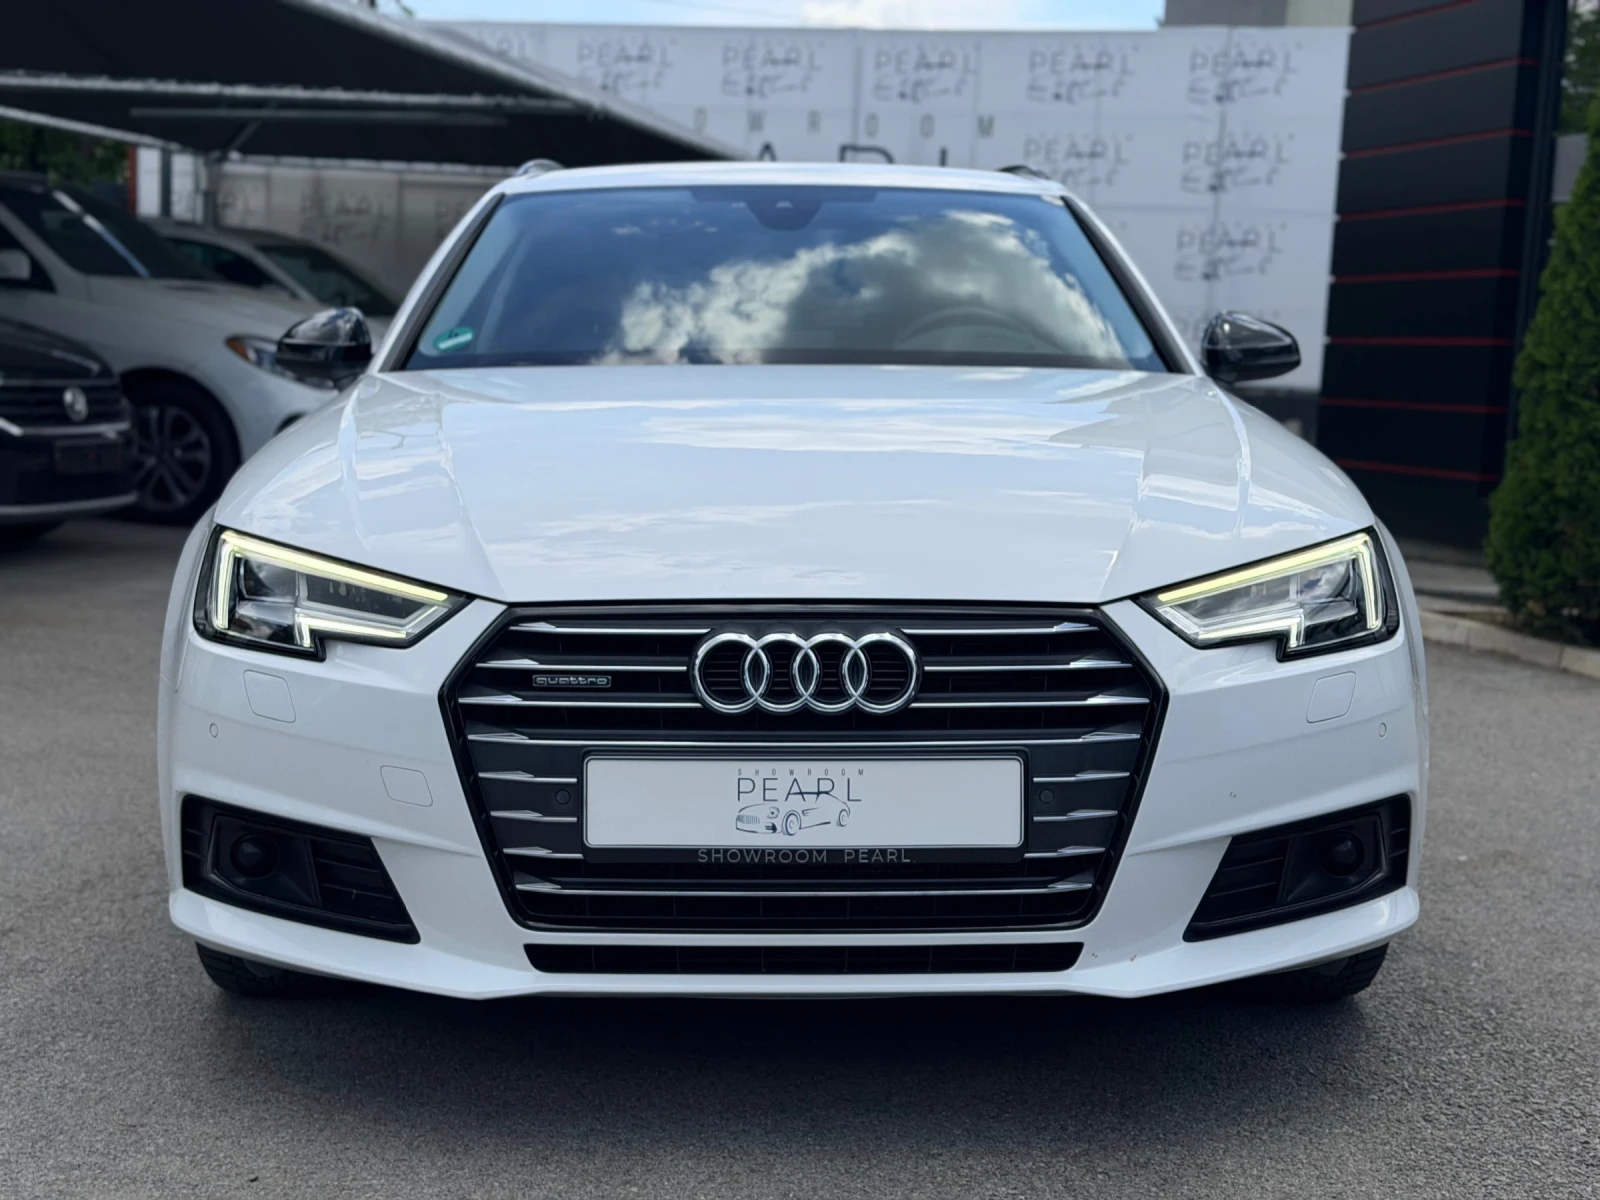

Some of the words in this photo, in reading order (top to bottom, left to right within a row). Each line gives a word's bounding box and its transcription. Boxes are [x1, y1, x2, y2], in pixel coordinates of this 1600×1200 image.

[536, 676, 608, 686] quattro
[737, 768, 864, 776] SHOWROOM
[737, 777, 862, 802] PEARL
[697, 849, 828, 864] SHOWROOM
